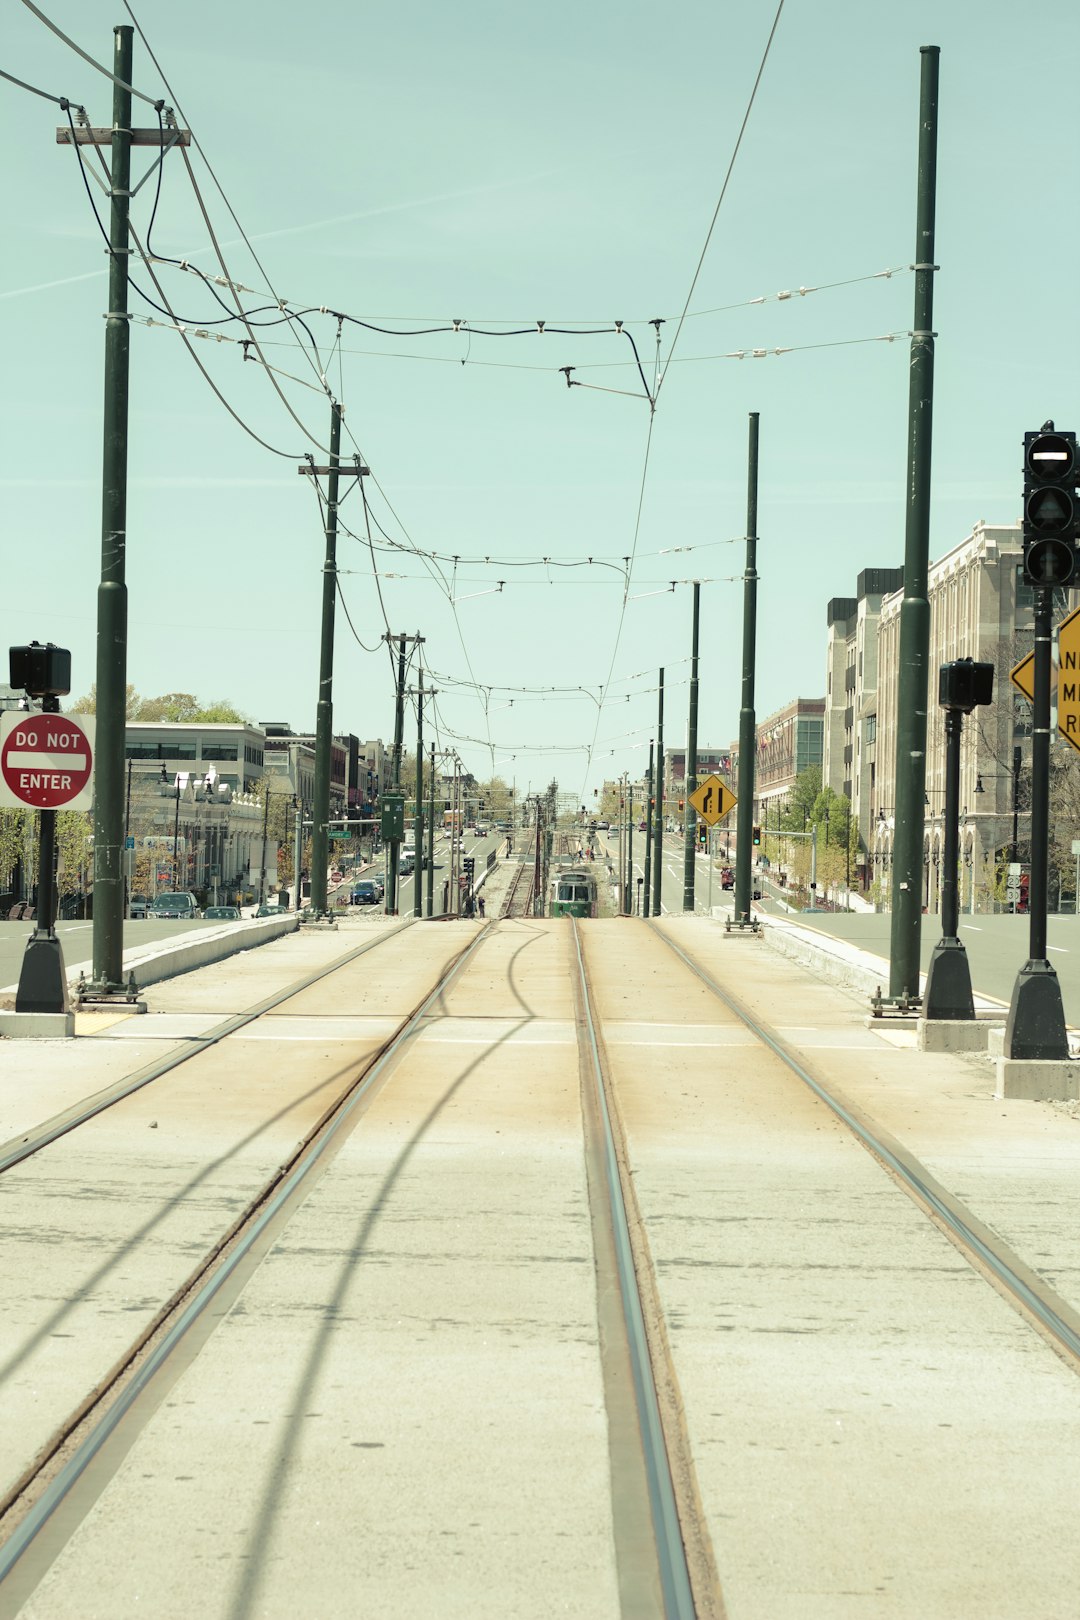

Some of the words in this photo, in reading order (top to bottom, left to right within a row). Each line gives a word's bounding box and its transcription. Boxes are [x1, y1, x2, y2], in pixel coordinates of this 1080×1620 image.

[16, 731, 38, 747] DO
[47, 732, 80, 749] NOT
[20, 773, 71, 790] ENTER
[1008, 891, 1020, 900] 30
